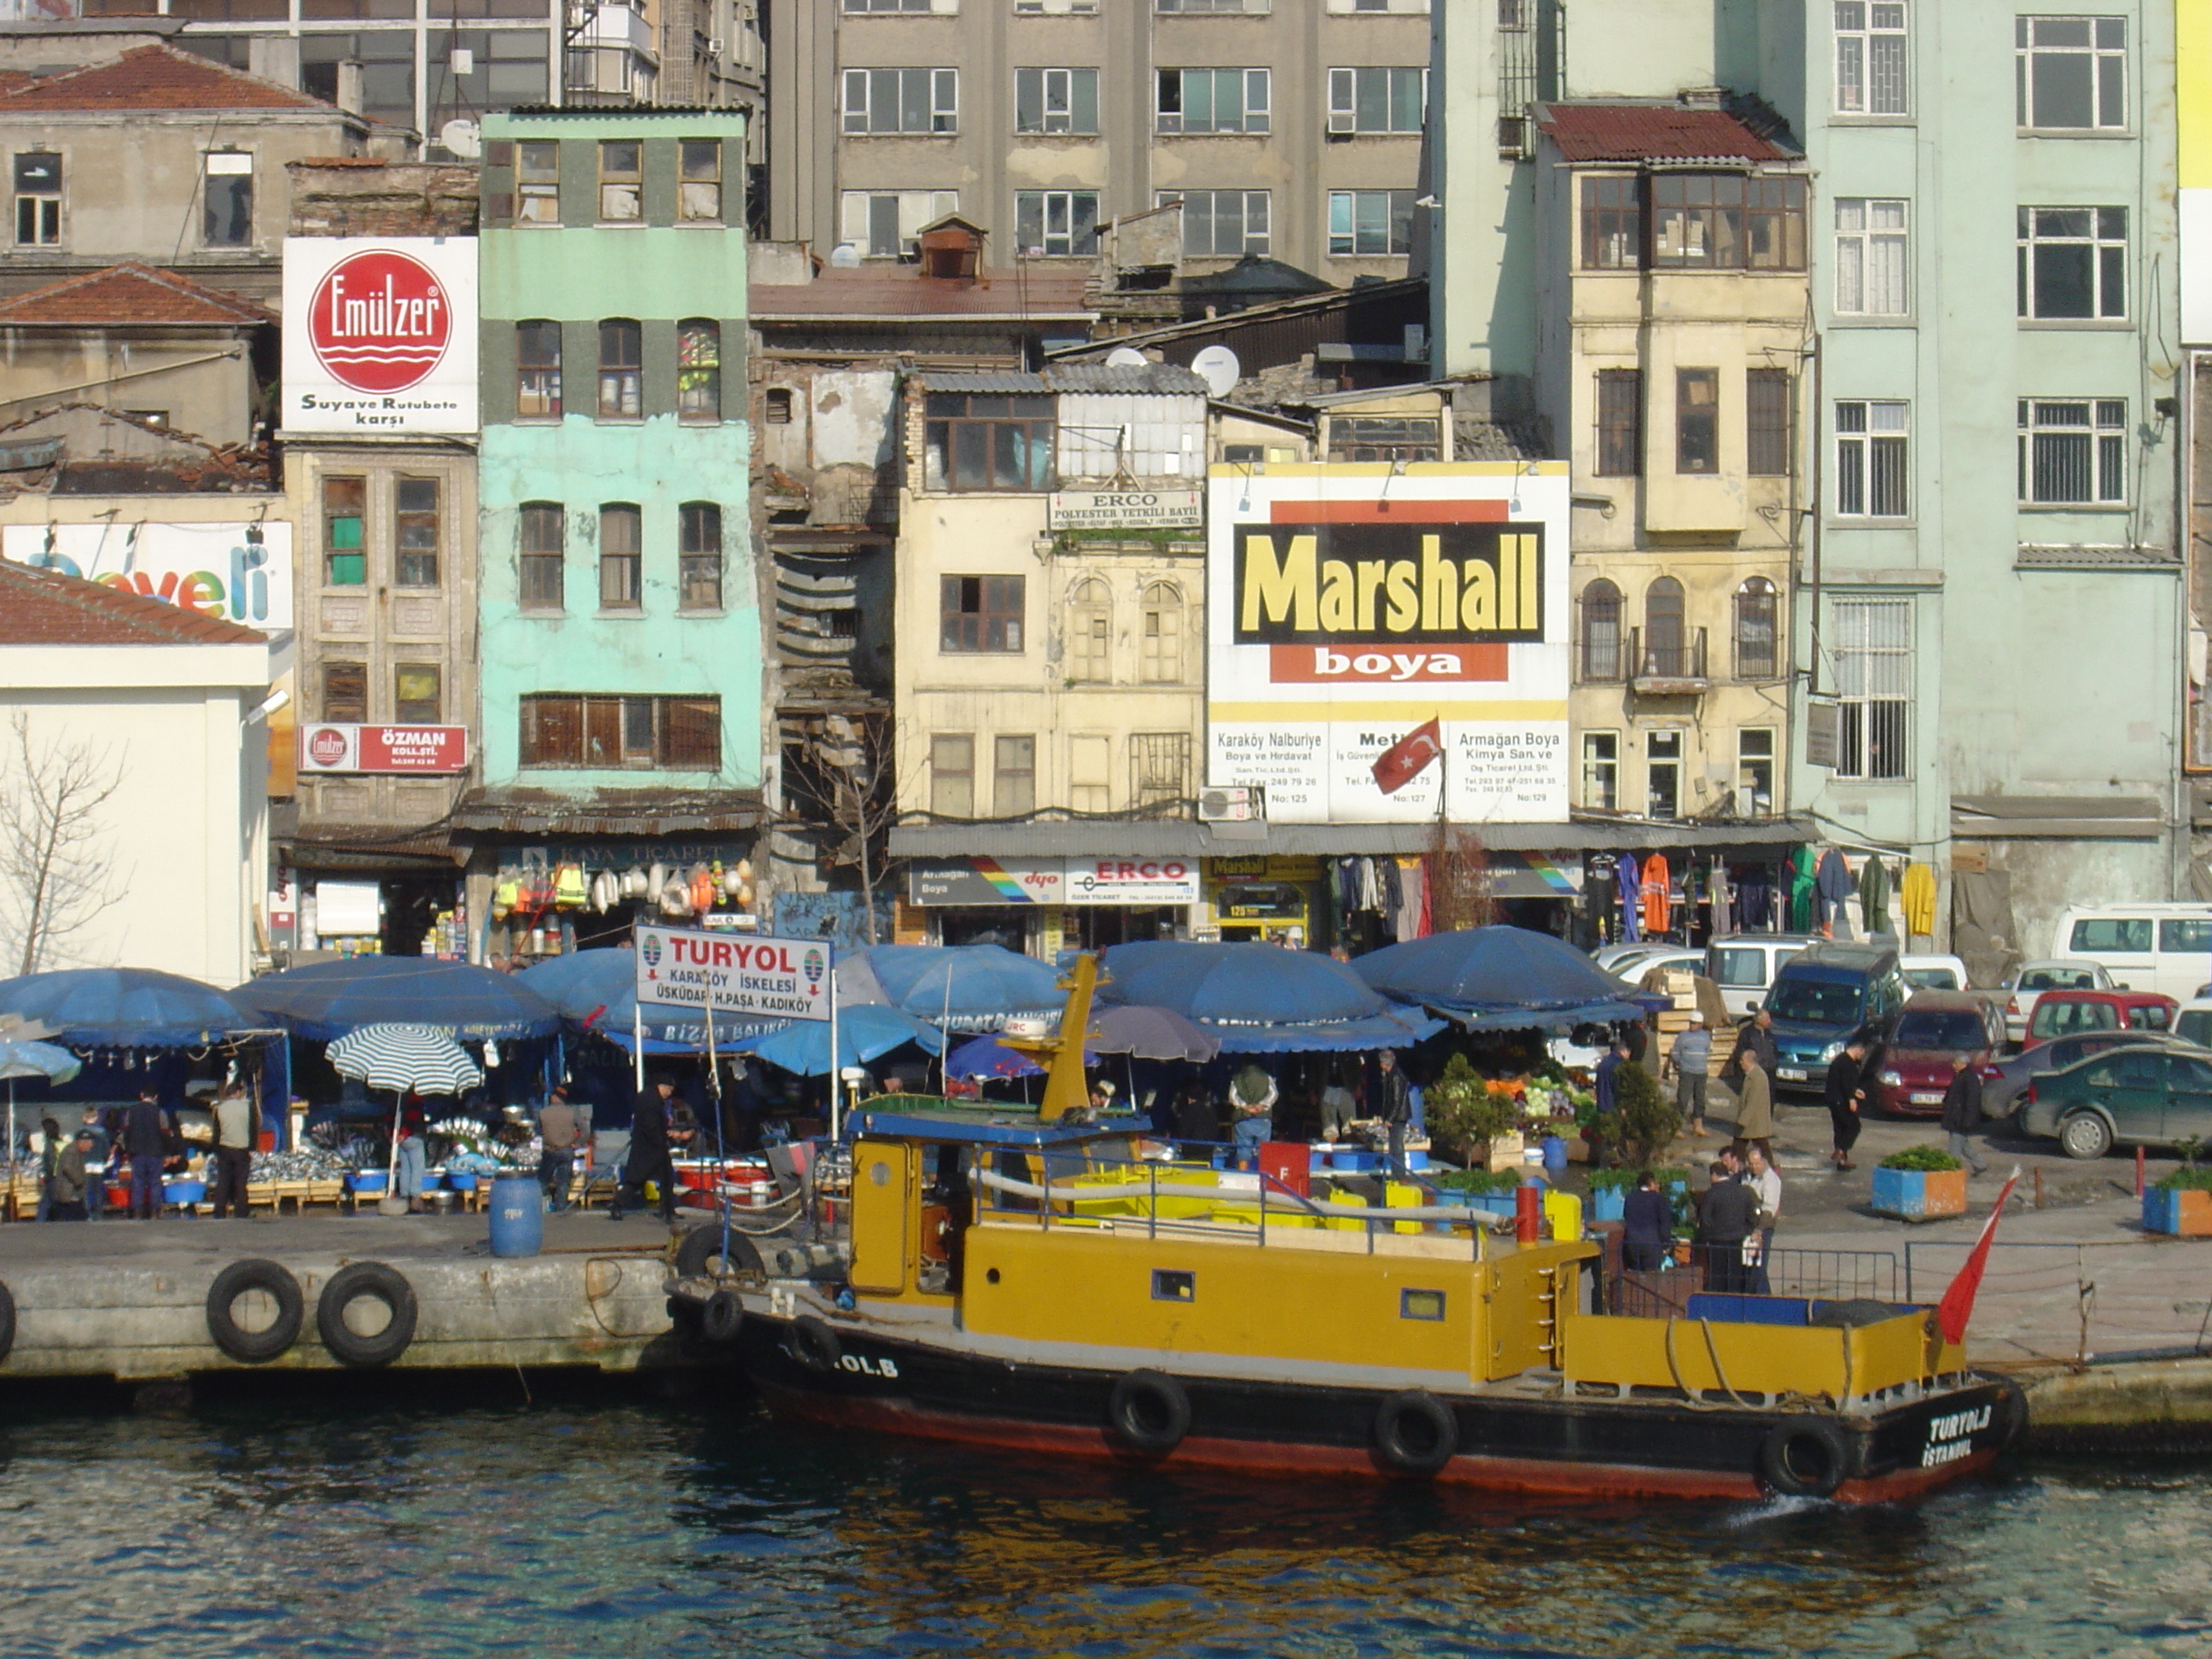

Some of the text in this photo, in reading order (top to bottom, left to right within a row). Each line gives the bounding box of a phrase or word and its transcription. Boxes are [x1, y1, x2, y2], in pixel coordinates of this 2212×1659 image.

[331, 274, 439, 336] Emülzer
[381, 398, 457, 409] Rutubete
[356, 413, 405, 428] karşı
[1092, 494, 1158, 507] ERCO
[1055, 509, 1117, 519] POLYESTER
[1122, 507, 1165, 518] YETKİLİ
[1241, 533, 1538, 632] Marshall
[1314, 647, 1462, 681] boya
[381, 729, 445, 745] ÖZMAN
[1218, 731, 1322, 750] Karaköy Nalburiye
[1459, 732, 1560, 749] Armağan Boya
[1225, 750, 1312, 763] Boya ve Hırdavat
[1466, 748, 1553, 761] Kimya San. ve
[1487, 764, 1516, 772] Ticaret
[1420, 777, 1430, 785] 75
[1097, 861, 1186, 880] ERCO
[1024, 871, 1059, 888] dyo
[922, 883, 948, 894] Boya
[669, 936, 797, 974] TURYOL
[740, 973, 796, 993] İSKELESİ
[715, 992, 754, 1010] H.PAŞA
[761, 996, 812, 1013] KADIKÖY
[1007, 1021, 1026, 1033] JRC
[1280, 1167, 1289, 1181] F
[833, 1354, 899, 1378] OL.B
